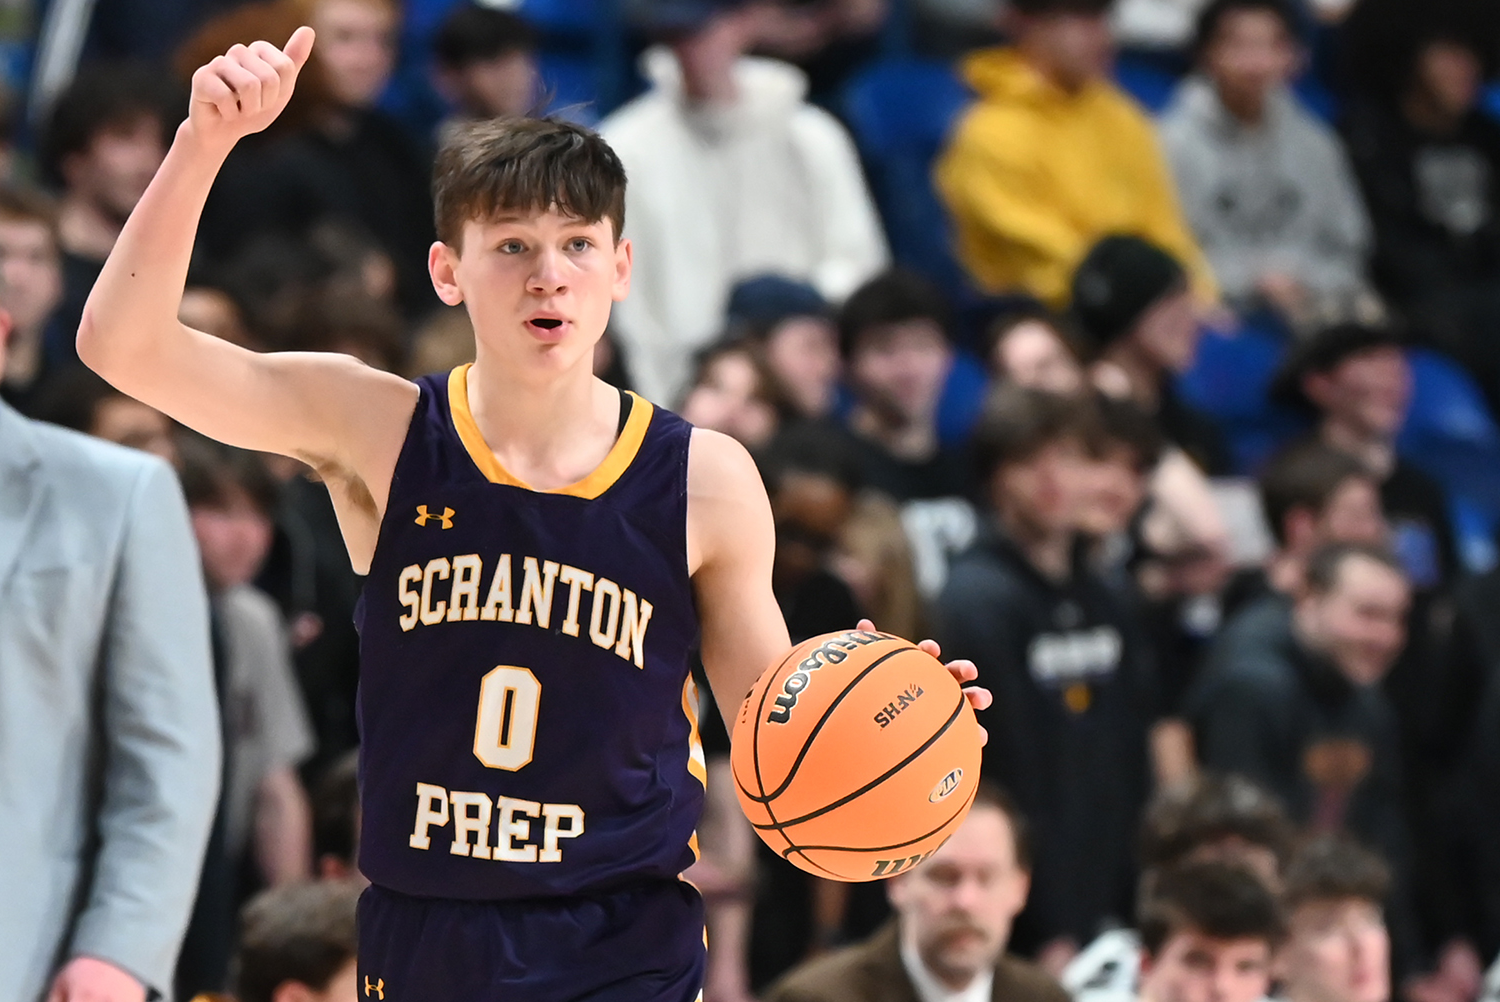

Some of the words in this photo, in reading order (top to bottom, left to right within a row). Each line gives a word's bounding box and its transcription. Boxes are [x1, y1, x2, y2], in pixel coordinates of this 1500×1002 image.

[398, 553, 654, 670] SCRANTON
[472, 664, 542, 772] 0
[873, 689, 916, 729] NFHS
[409, 782, 585, 863] PREP
